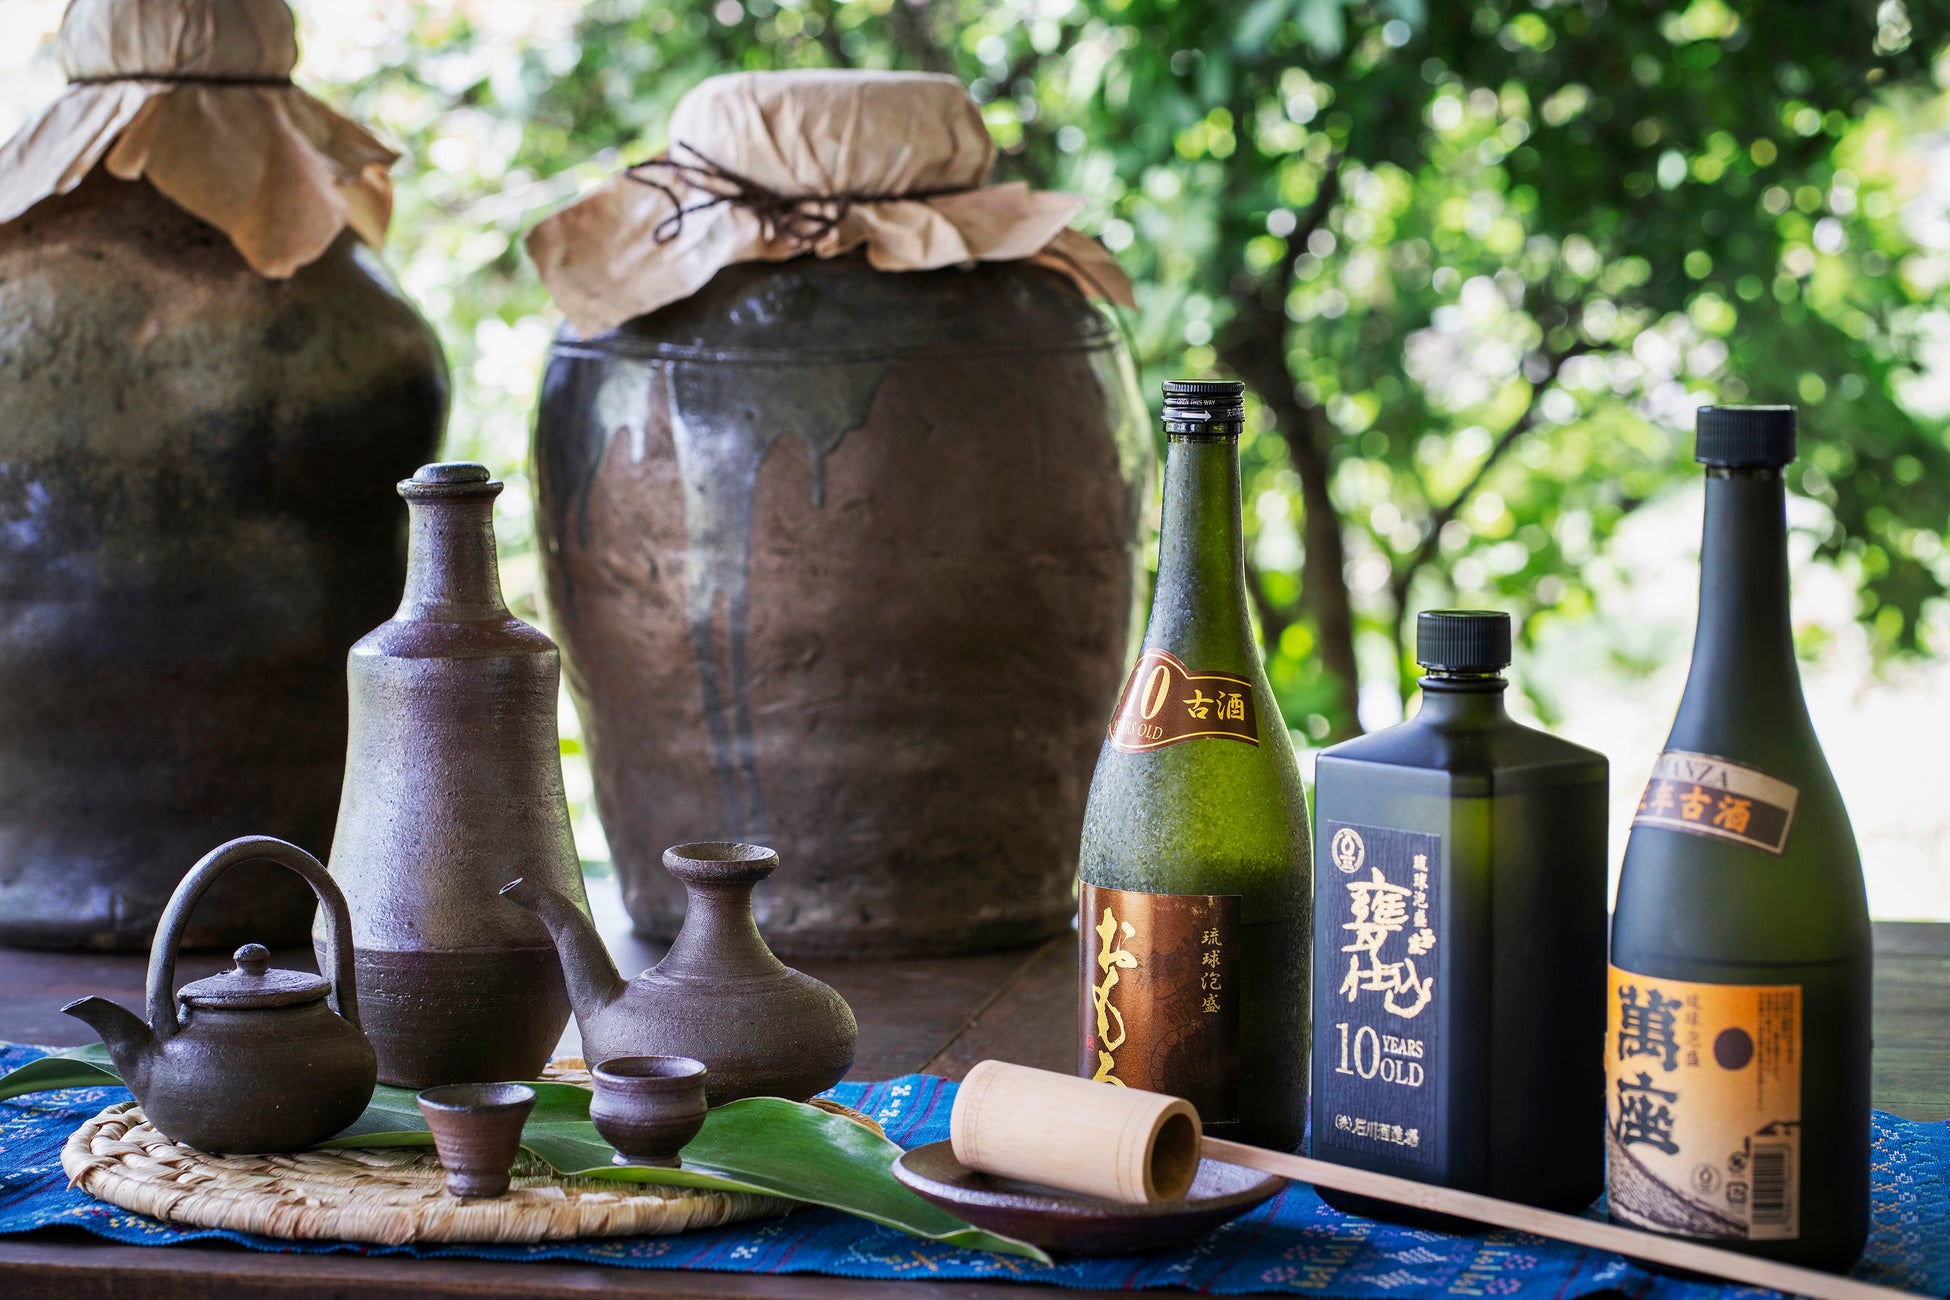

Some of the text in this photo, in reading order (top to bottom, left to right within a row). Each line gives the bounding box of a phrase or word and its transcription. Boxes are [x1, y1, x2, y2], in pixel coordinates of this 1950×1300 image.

[1121, 664, 1171, 720] 10
[1182, 689, 1245, 721] 古酒
[1138, 723, 1163, 740] OLD
[1201, 927, 1222, 1013] 琉球泡盛
[1334, 1022, 1381, 1080] 10
[1381, 1034, 1424, 1059] YEARS
[1379, 1057, 1425, 1087] OLD
